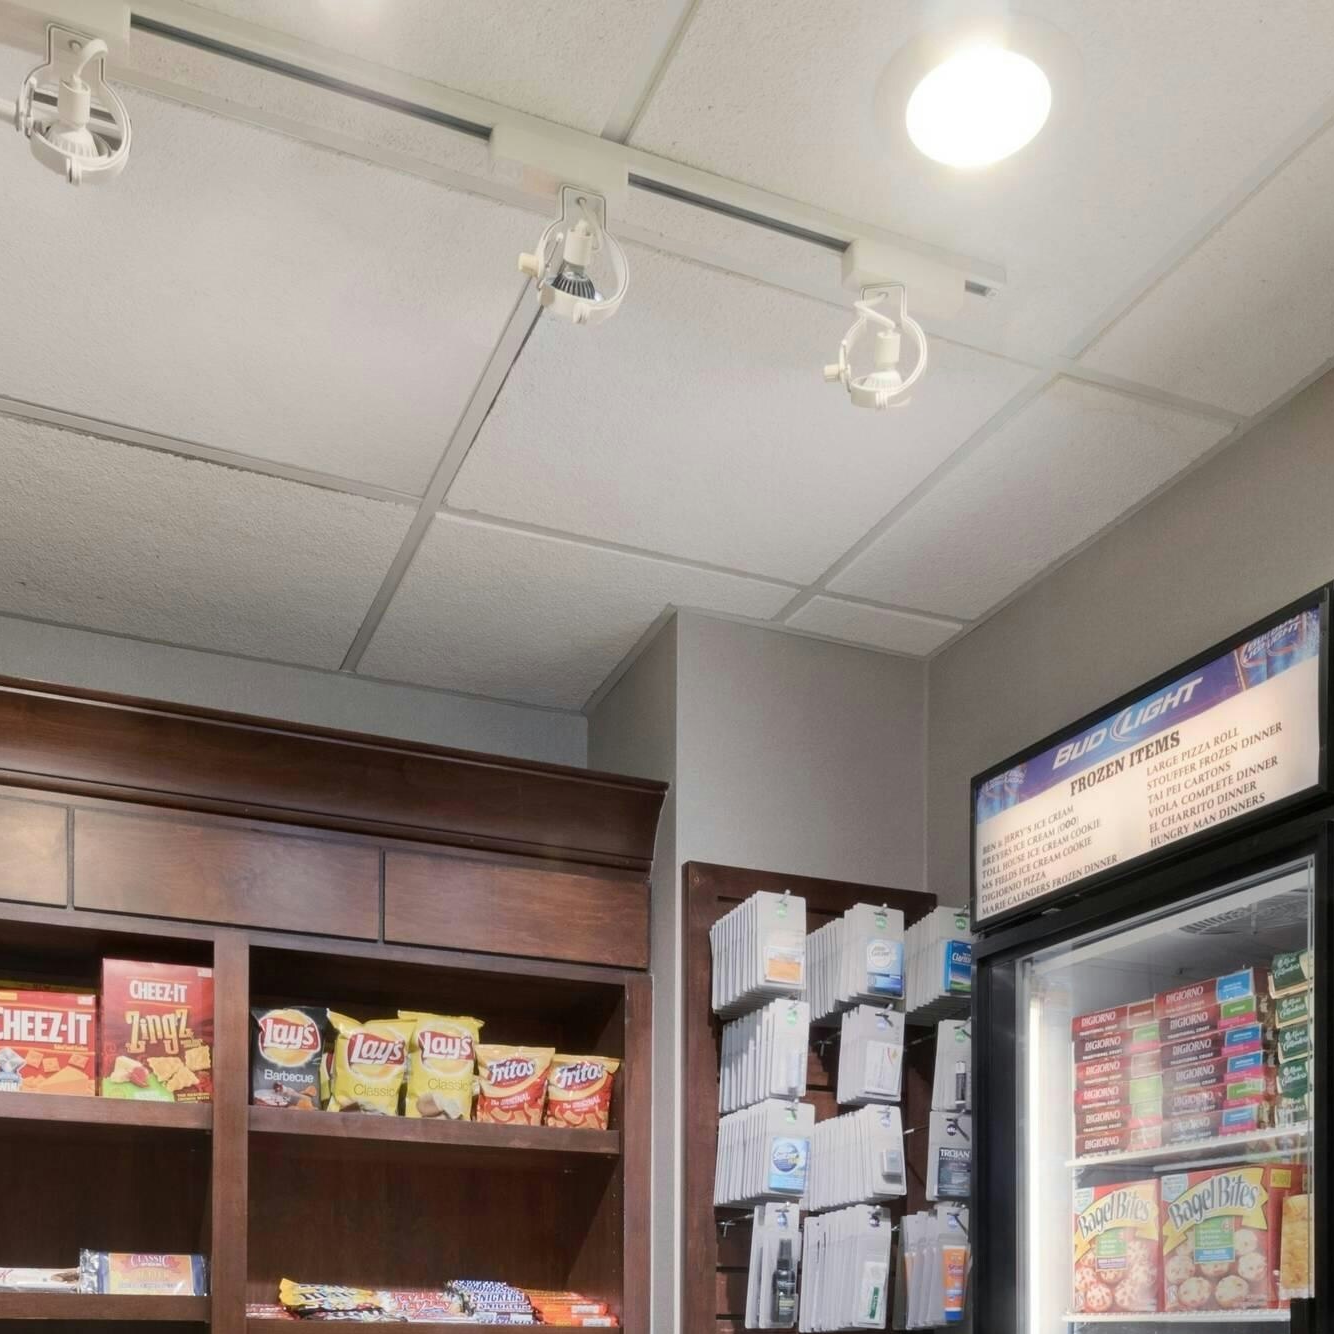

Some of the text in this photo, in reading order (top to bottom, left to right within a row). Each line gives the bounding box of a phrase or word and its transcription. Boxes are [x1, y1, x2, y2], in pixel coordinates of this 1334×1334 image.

[1052, 677, 1203, 770] BUD LIGHT
[1070, 757, 1126, 797] FROZEN
[1129, 730, 1181, 768] ITEMS
[1147, 727, 1240, 776] LARGE PIZZA ROLL
[1147, 722, 1282, 790] STOUFFER FROZEN DINNER
[1148, 755, 1278, 819] VIOLA COMPLETE DINNER
[1184, 760, 1231, 789] CARTONS
[1150, 792, 1266, 848] HUNGRY DINNERS
[1161, 780, 1257, 827] CHARRITO DINNER
[1052, 853, 1117, 888] FROZEN DINNER
[129, 980, 188, 1003] CHEEZ-IT
[125, 1008, 194, 1055] Zingz
[265, 1016, 314, 1050] Lay's
[351, 1032, 406, 1065] Lay's
[422, 1030, 472, 1060] Lay's
[264, 1069, 314, 1084] Barbecue
[489, 1056, 535, 1086] Fritos
[556, 1060, 605, 1089] Fritos
[353, 1082, 395, 1097] Classic
[1171, 1176, 1216, 1231] Bagel
[1218, 1171, 1258, 1208] Bites
